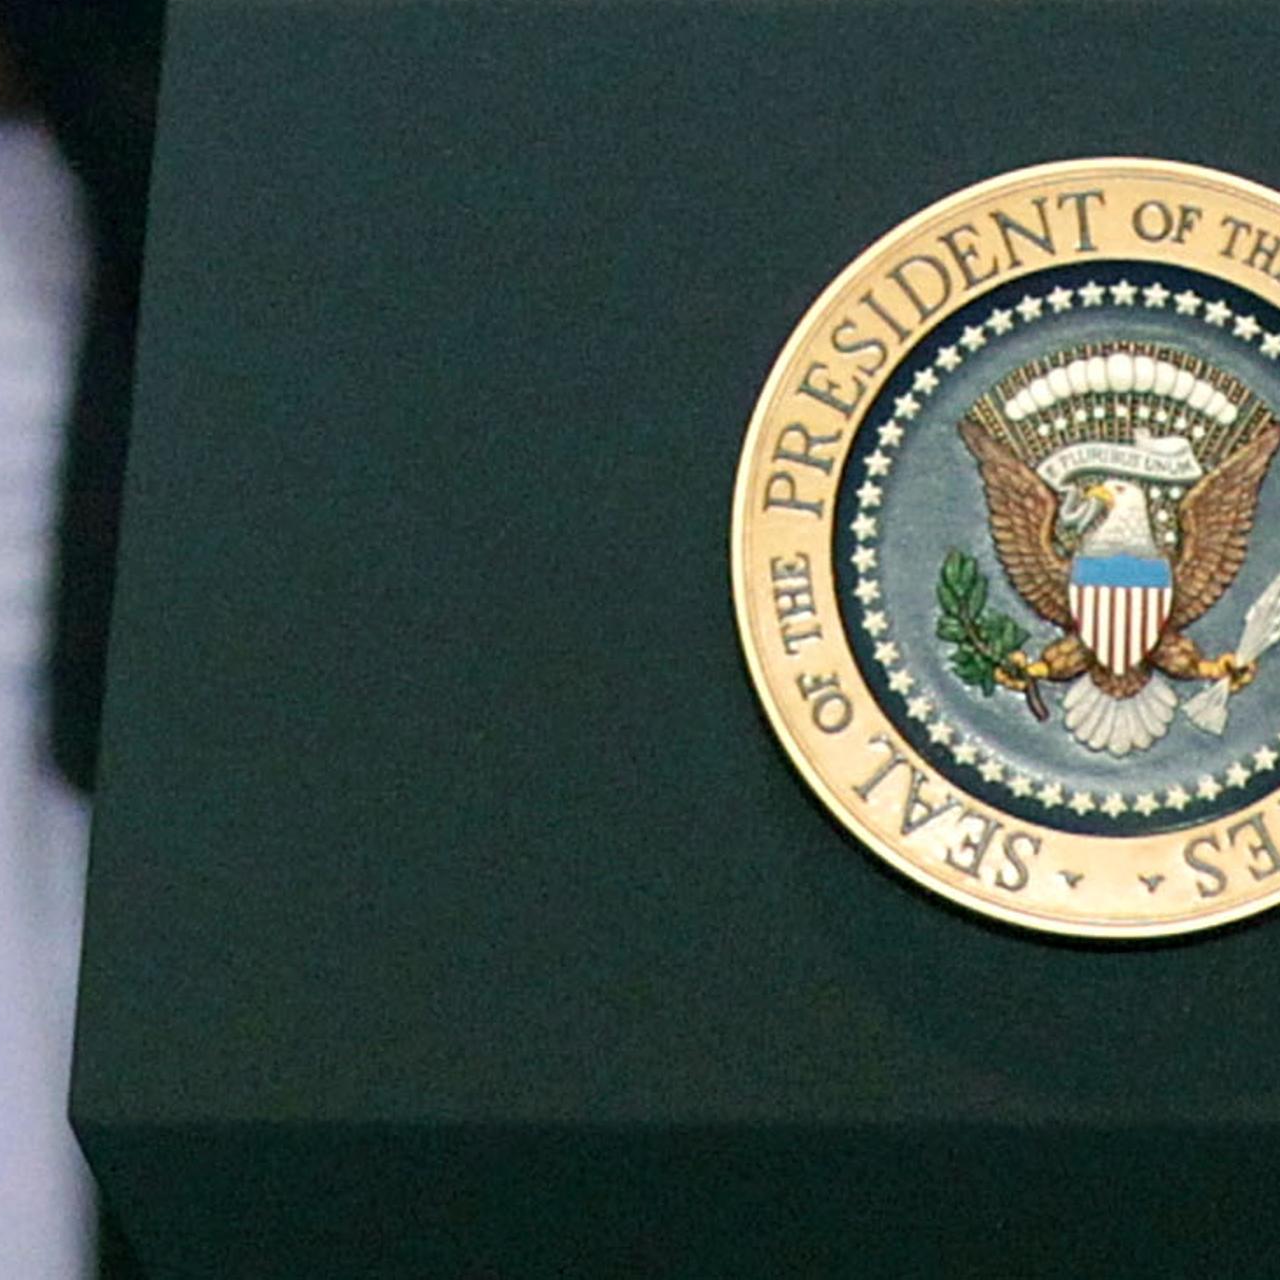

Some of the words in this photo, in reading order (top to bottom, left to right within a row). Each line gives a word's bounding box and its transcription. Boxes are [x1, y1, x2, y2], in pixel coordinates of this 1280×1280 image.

[1131, 198, 1203, 244] OF
[763, 189, 1105, 520] PRESIDENT
[768, 550, 824, 655] THE
[800, 670, 854, 735] OF
[852, 716, 1043, 896] SEAL
